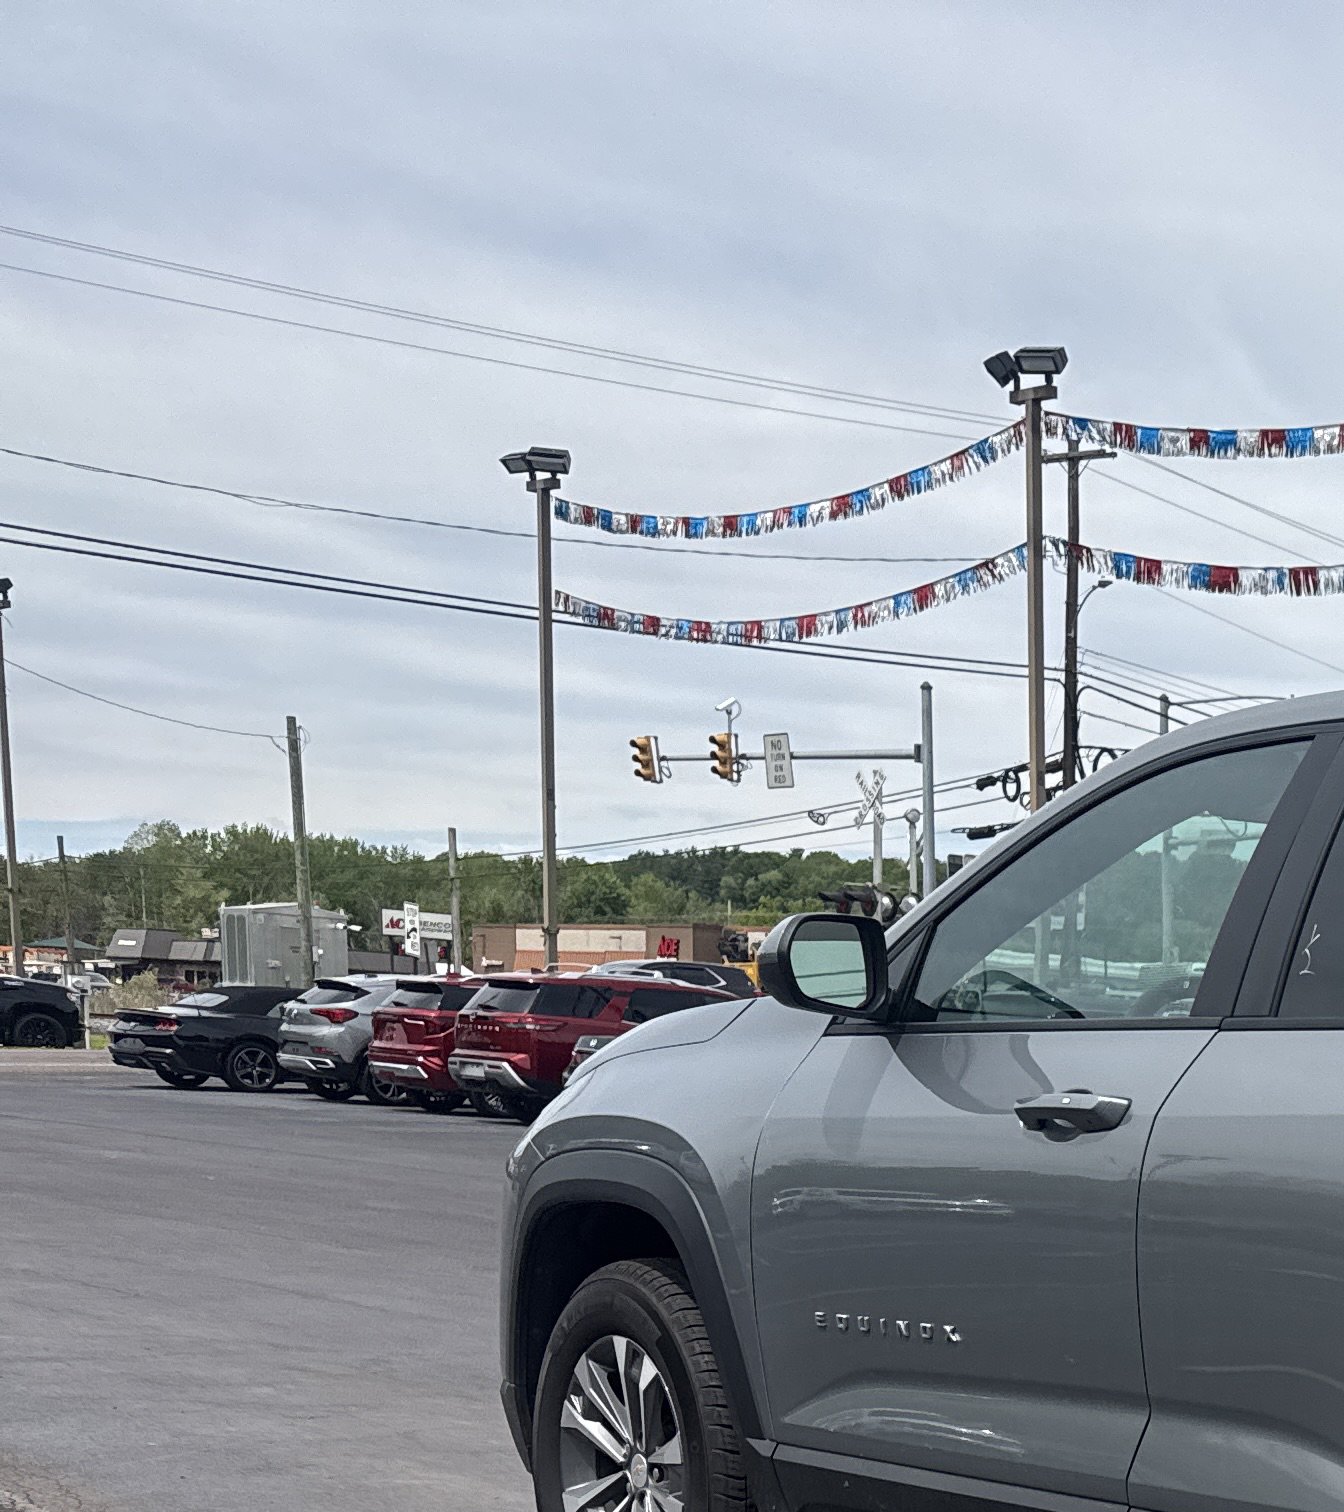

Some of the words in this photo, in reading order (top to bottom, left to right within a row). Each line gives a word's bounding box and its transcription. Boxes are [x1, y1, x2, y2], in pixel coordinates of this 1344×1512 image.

[770, 739, 782, 751] NO
[770, 752, 786, 762] TURN
[814, 1311, 963, 1342] EQUINOX
